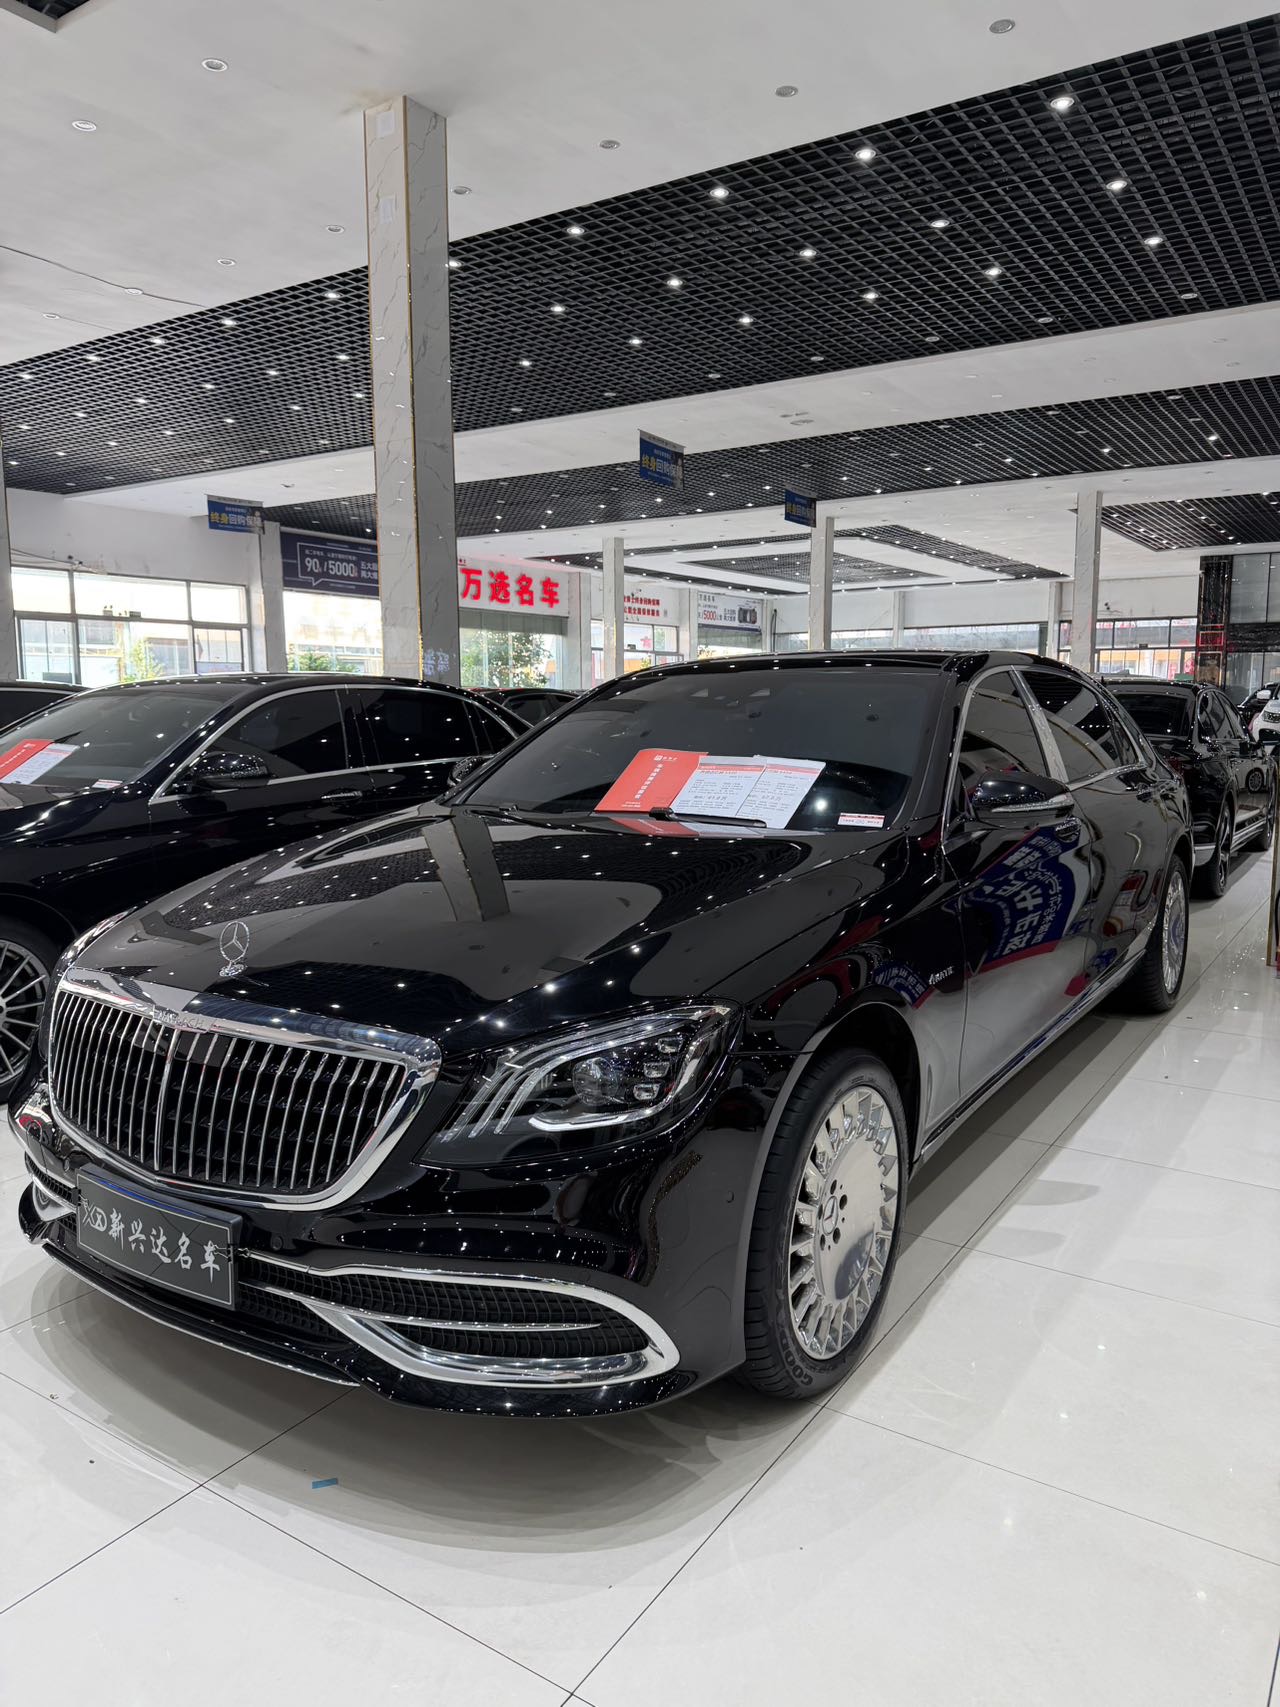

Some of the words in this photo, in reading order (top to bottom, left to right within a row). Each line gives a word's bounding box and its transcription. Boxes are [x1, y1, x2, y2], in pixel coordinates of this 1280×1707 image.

[460, 567, 560, 608] 万选名车
[108, 1207, 221, 1284] 新兴达名车
